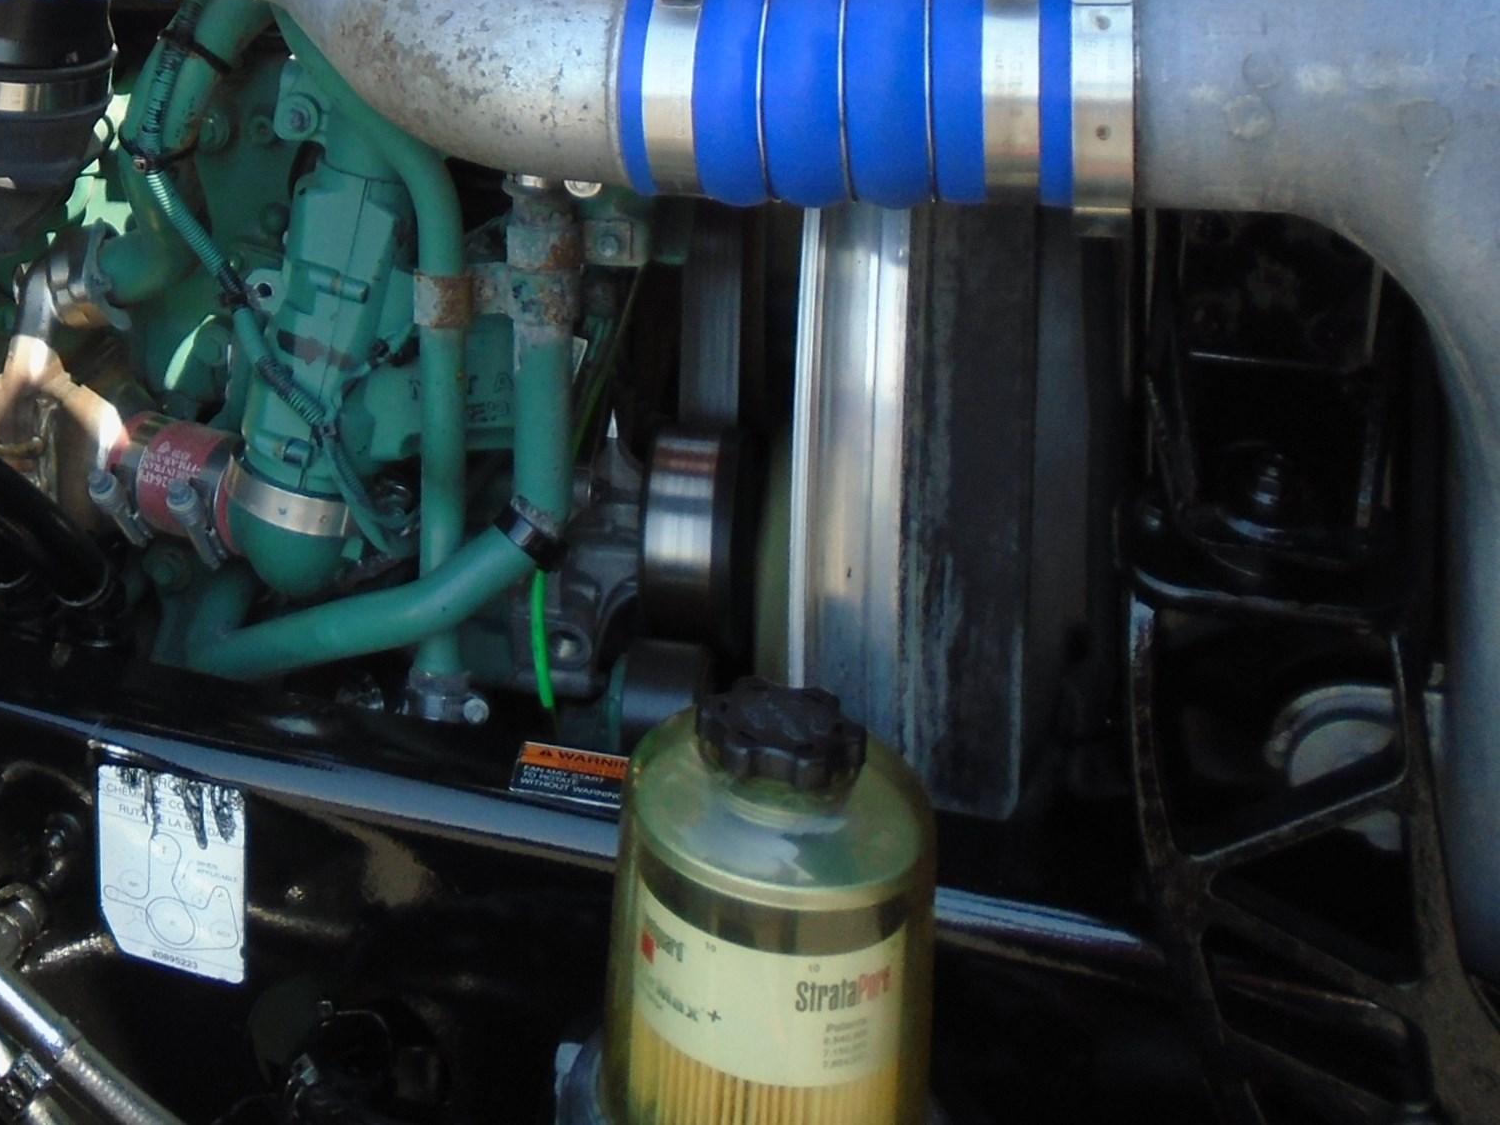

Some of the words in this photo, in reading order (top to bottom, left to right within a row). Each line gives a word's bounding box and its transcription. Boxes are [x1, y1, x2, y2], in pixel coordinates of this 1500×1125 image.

[557, 750, 629, 768] WARNIN
[523, 764, 546, 774] FAN
[546, 767, 568, 777] MAY
[572, 772, 605, 783] START
[538, 773, 579, 786] ROTATE
[519, 777, 569, 792] WITHOUT
